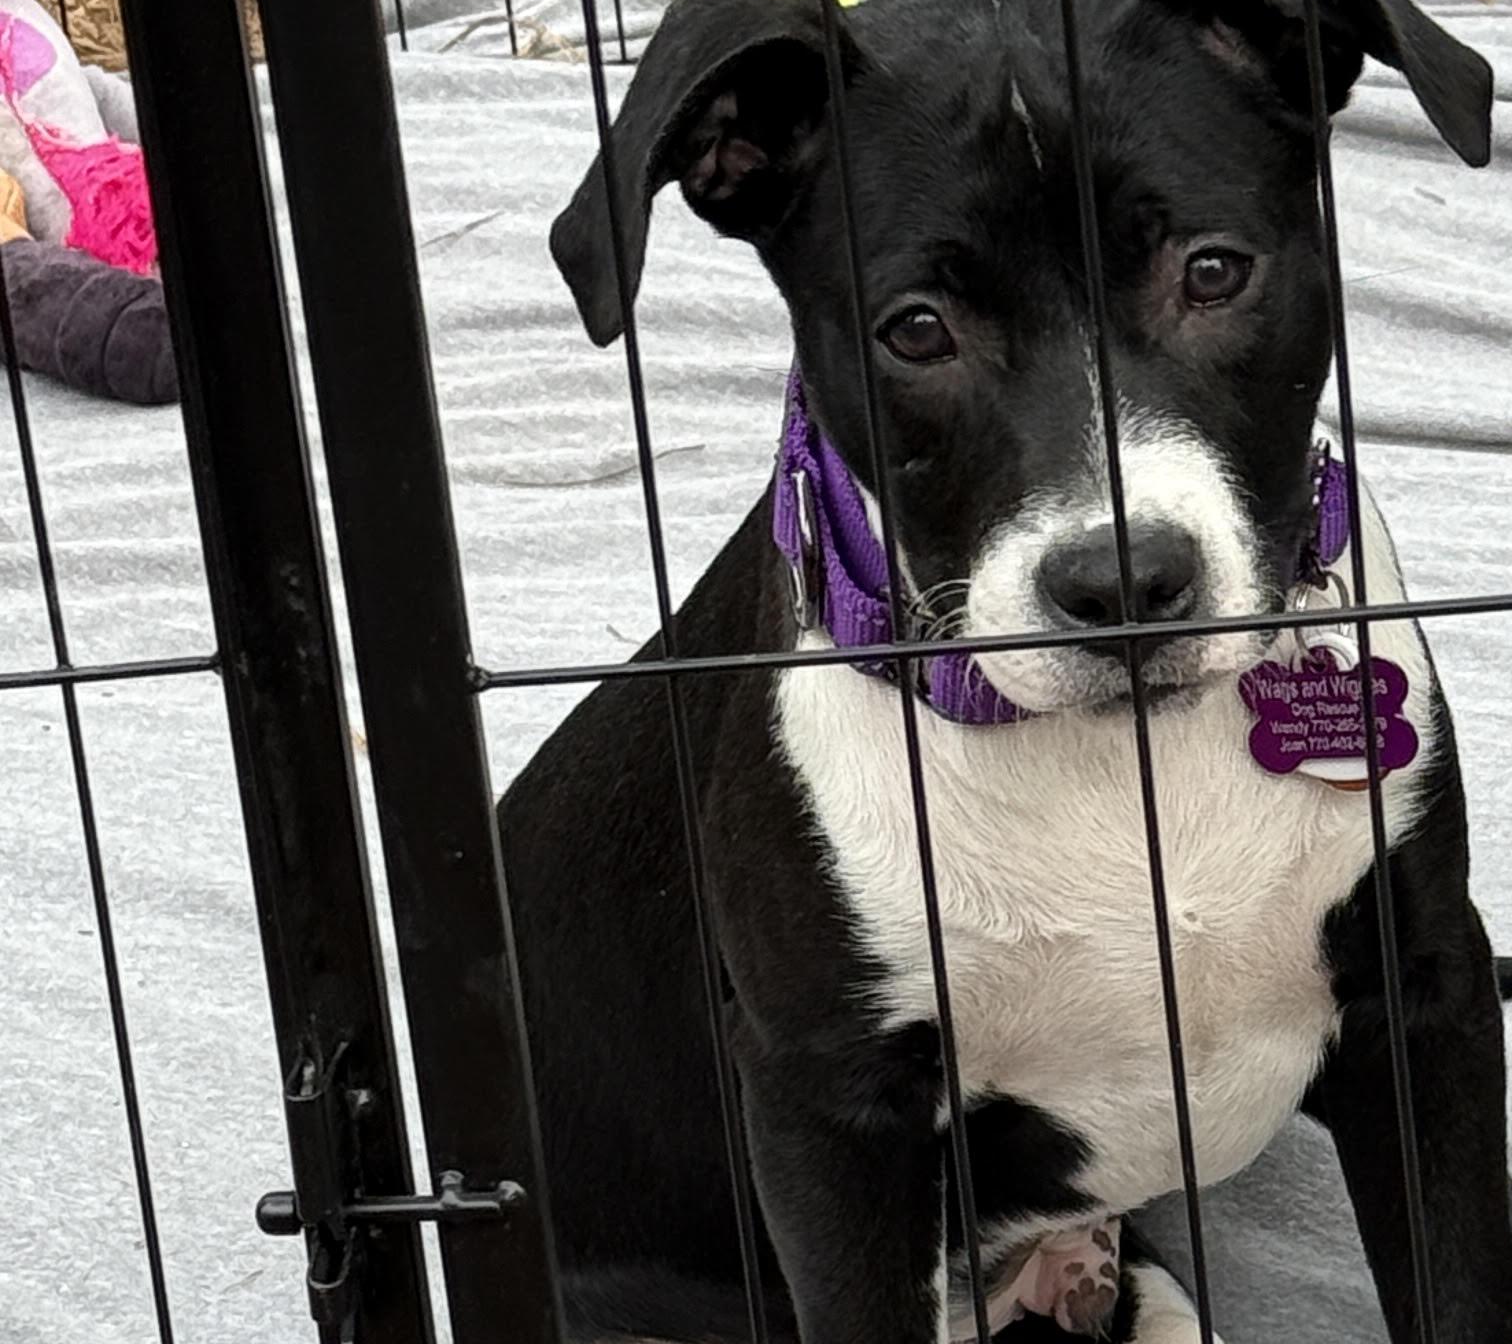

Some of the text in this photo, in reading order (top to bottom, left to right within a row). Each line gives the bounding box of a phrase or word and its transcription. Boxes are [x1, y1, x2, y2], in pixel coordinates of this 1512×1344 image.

[1257, 677, 1299, 705] Wags
[1301, 676, 1328, 699] and
[1291, 700, 1360, 718] Dog Rescue
